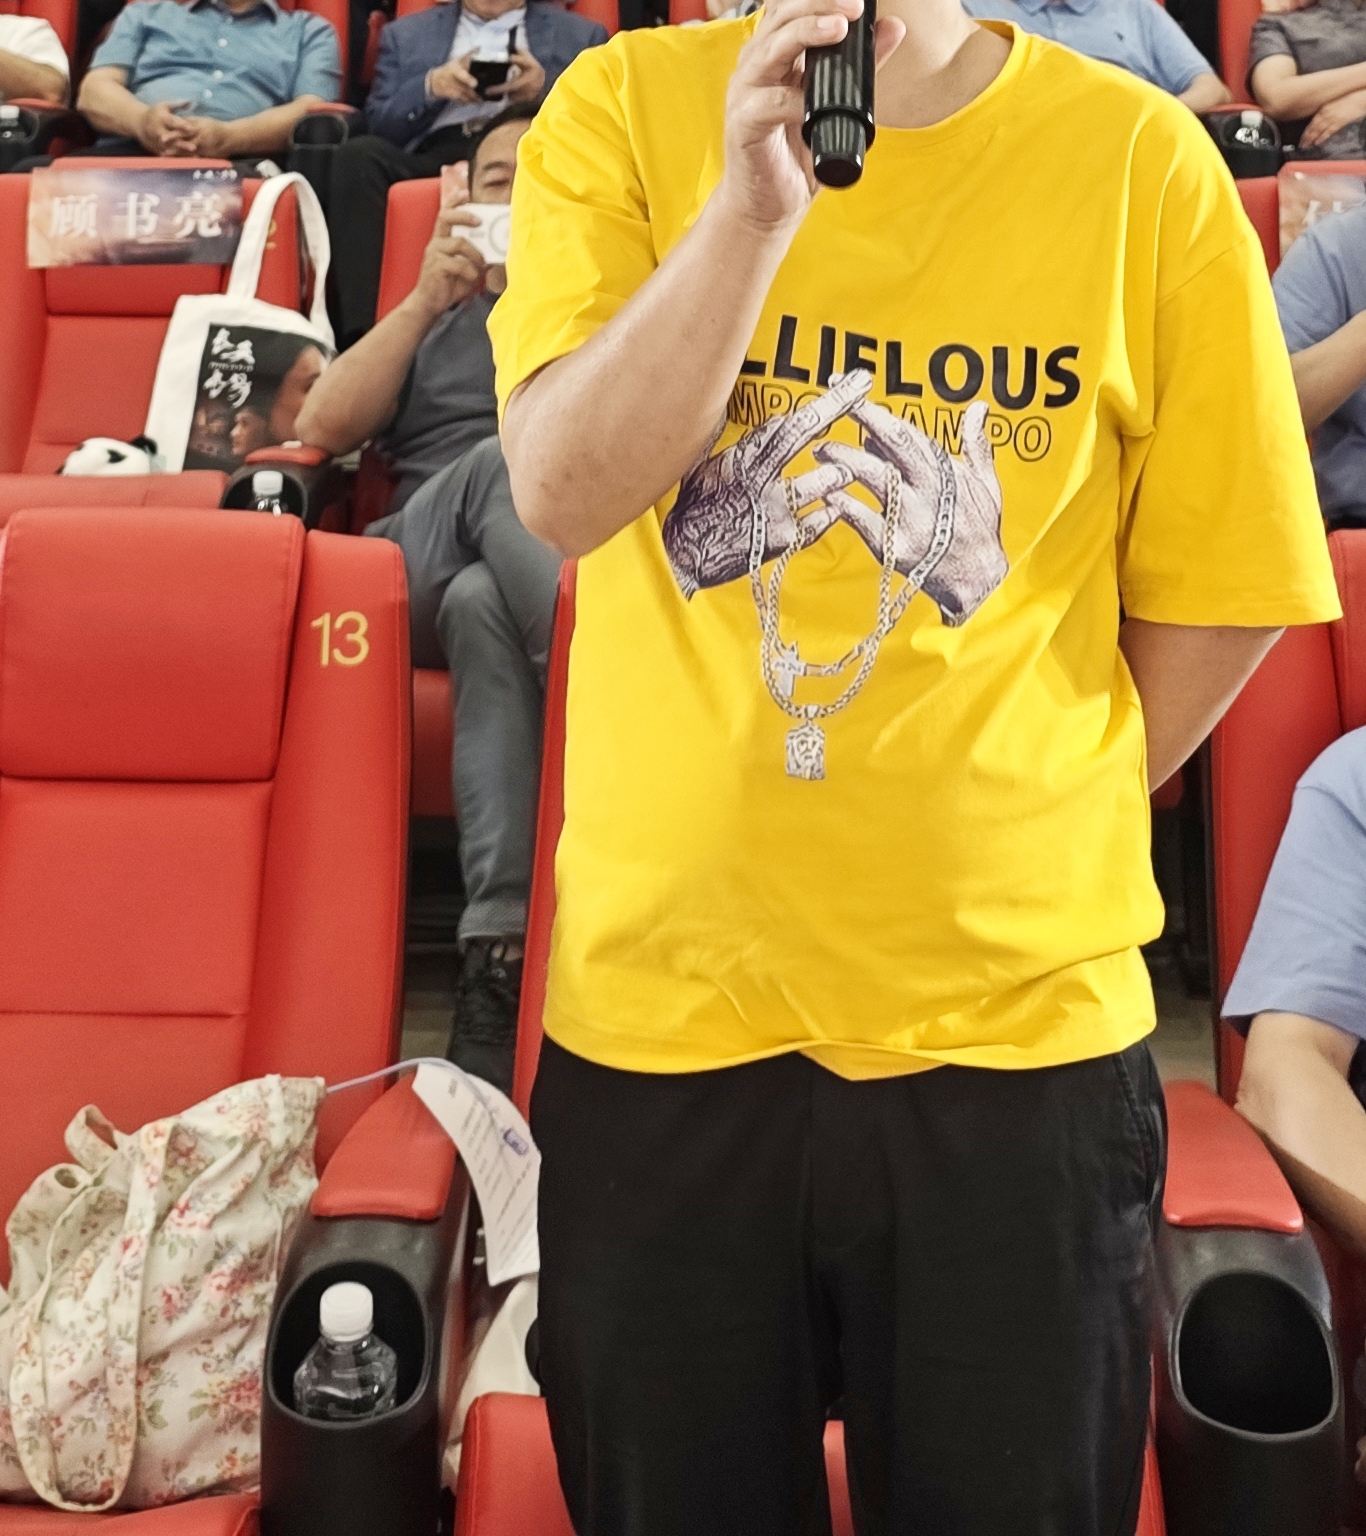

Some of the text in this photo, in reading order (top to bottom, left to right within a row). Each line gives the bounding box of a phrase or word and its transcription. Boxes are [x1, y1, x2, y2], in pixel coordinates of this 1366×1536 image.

[48, 191, 224, 240] 顾书亮
[310, 610, 370, 667] 13
